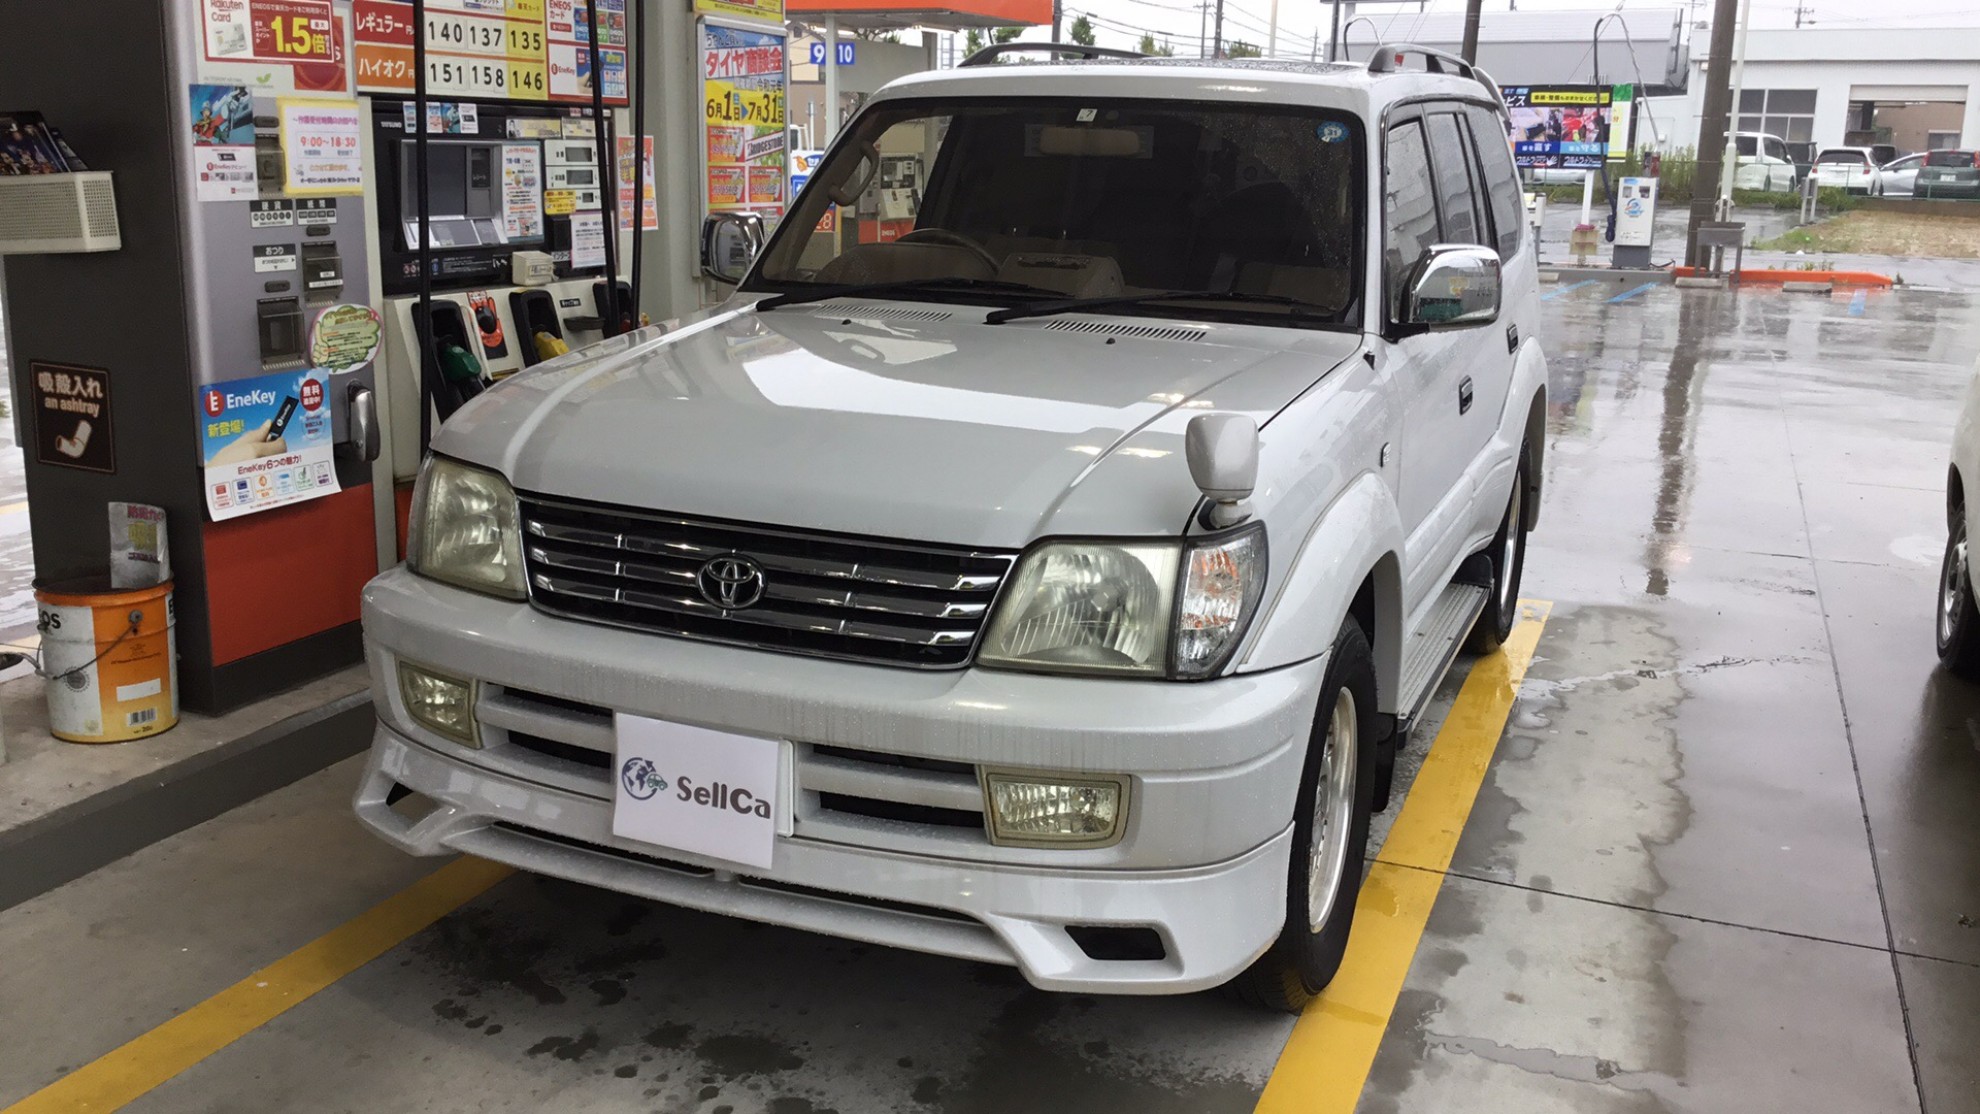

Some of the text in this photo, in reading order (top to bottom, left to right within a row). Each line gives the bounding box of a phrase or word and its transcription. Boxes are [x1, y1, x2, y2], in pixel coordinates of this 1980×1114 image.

[211, 12, 231, 22] Card
[356, 12, 403, 33] レギュラー
[428, 21, 541, 51] 140 137 135
[813, 44, 853, 63] 9 10
[359, 58, 406, 78] ハイオク
[430, 63, 543, 91] 151 158 146
[265, 246, 284, 256] おつり
[38, 371, 103, 398] 吸殻入れ
[45, 397, 99, 418] an ashtray
[226, 390, 276, 409] EneKey
[208, 419, 244, 438] 新登場!
[677, 776, 771, 819] SellCa
